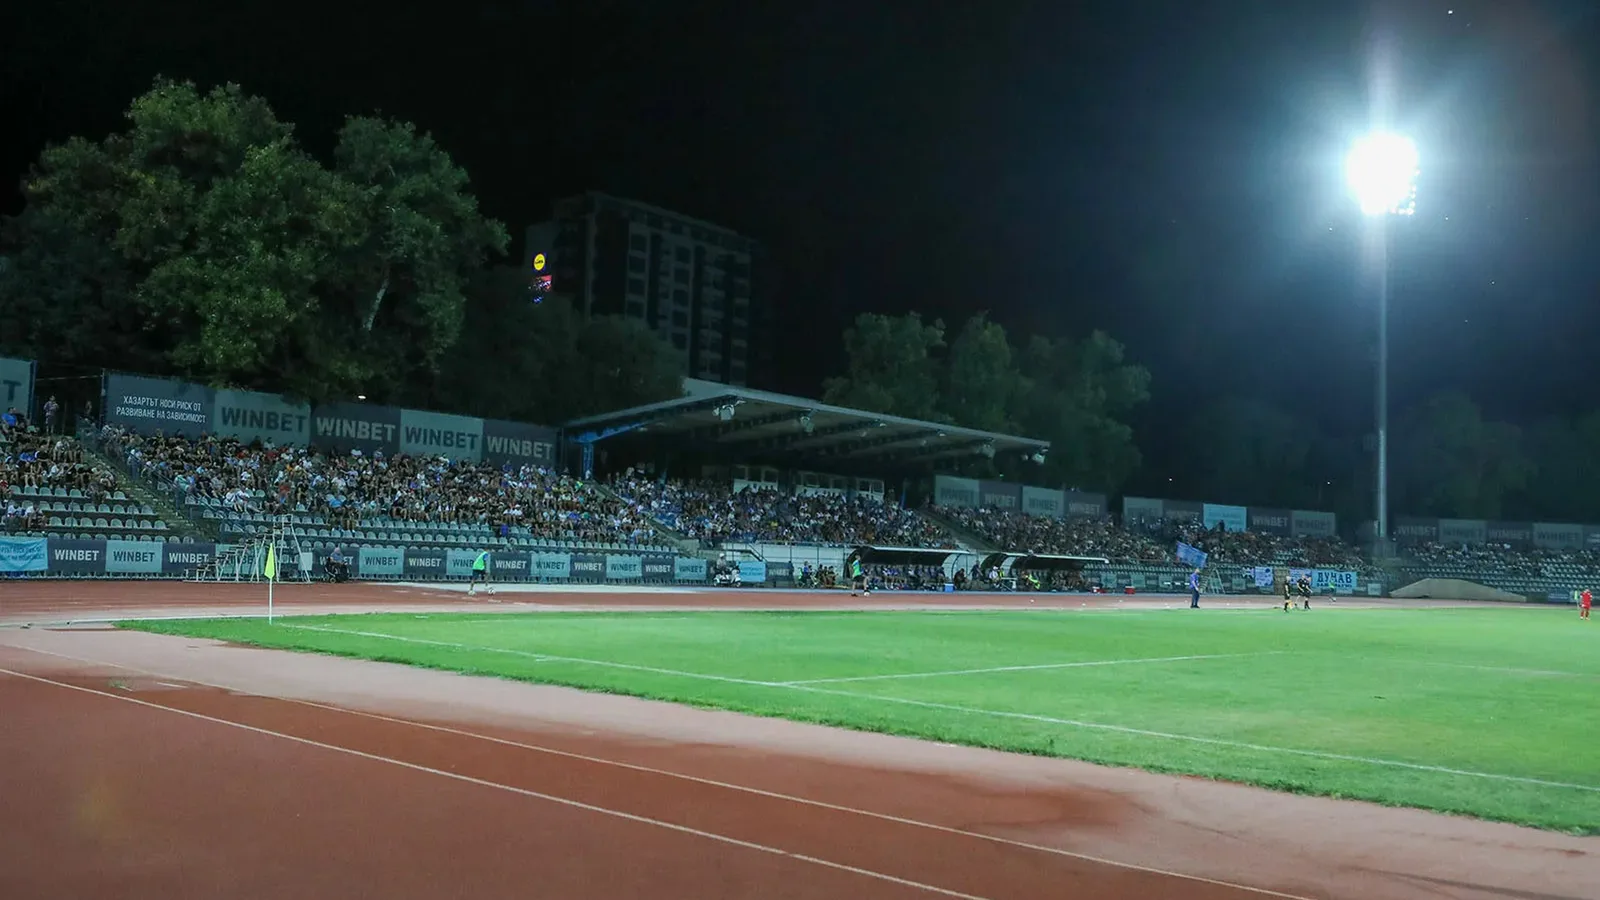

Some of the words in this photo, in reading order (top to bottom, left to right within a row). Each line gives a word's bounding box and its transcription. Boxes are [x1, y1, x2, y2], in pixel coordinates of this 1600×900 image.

[123, 395, 158, 407] ХАЗАРТЪТ
[159, 399, 176, 408] НОСИ
[176, 400, 193, 411] РИСК
[193, 402, 202, 412] ОТ
[116, 406, 156, 418] РАЗВИВАНЕ
[156, 410, 165, 419] НА
[166, 410, 206, 423] ЗАВИСИМОСТ
[221, 406, 308, 433] WINBET
[316, 416, 396, 442] WINBET
[405, 425, 479, 450] WINBET
[487, 435, 553, 460] WINBET
[1252, 514, 1289, 528] WINBET
[54, 548, 100, 561] WINBET
[113, 550, 155, 563] WINBET
[168, 552, 209, 564] WINBET
[319, 556, 354, 566] WET
[365, 556, 399, 566] WINBET
[408, 557, 441, 567] WINBET
[452, 558, 474, 568] WINB
[495, 560, 527, 569] WINBET
[536, 561, 566, 570] WINBET
[574, 562, 602, 571] WINBET
[610, 563, 637, 572] WINBET
[645, 564, 672, 573] WINBET
[1317, 572, 1352, 584] ДУНАВ
